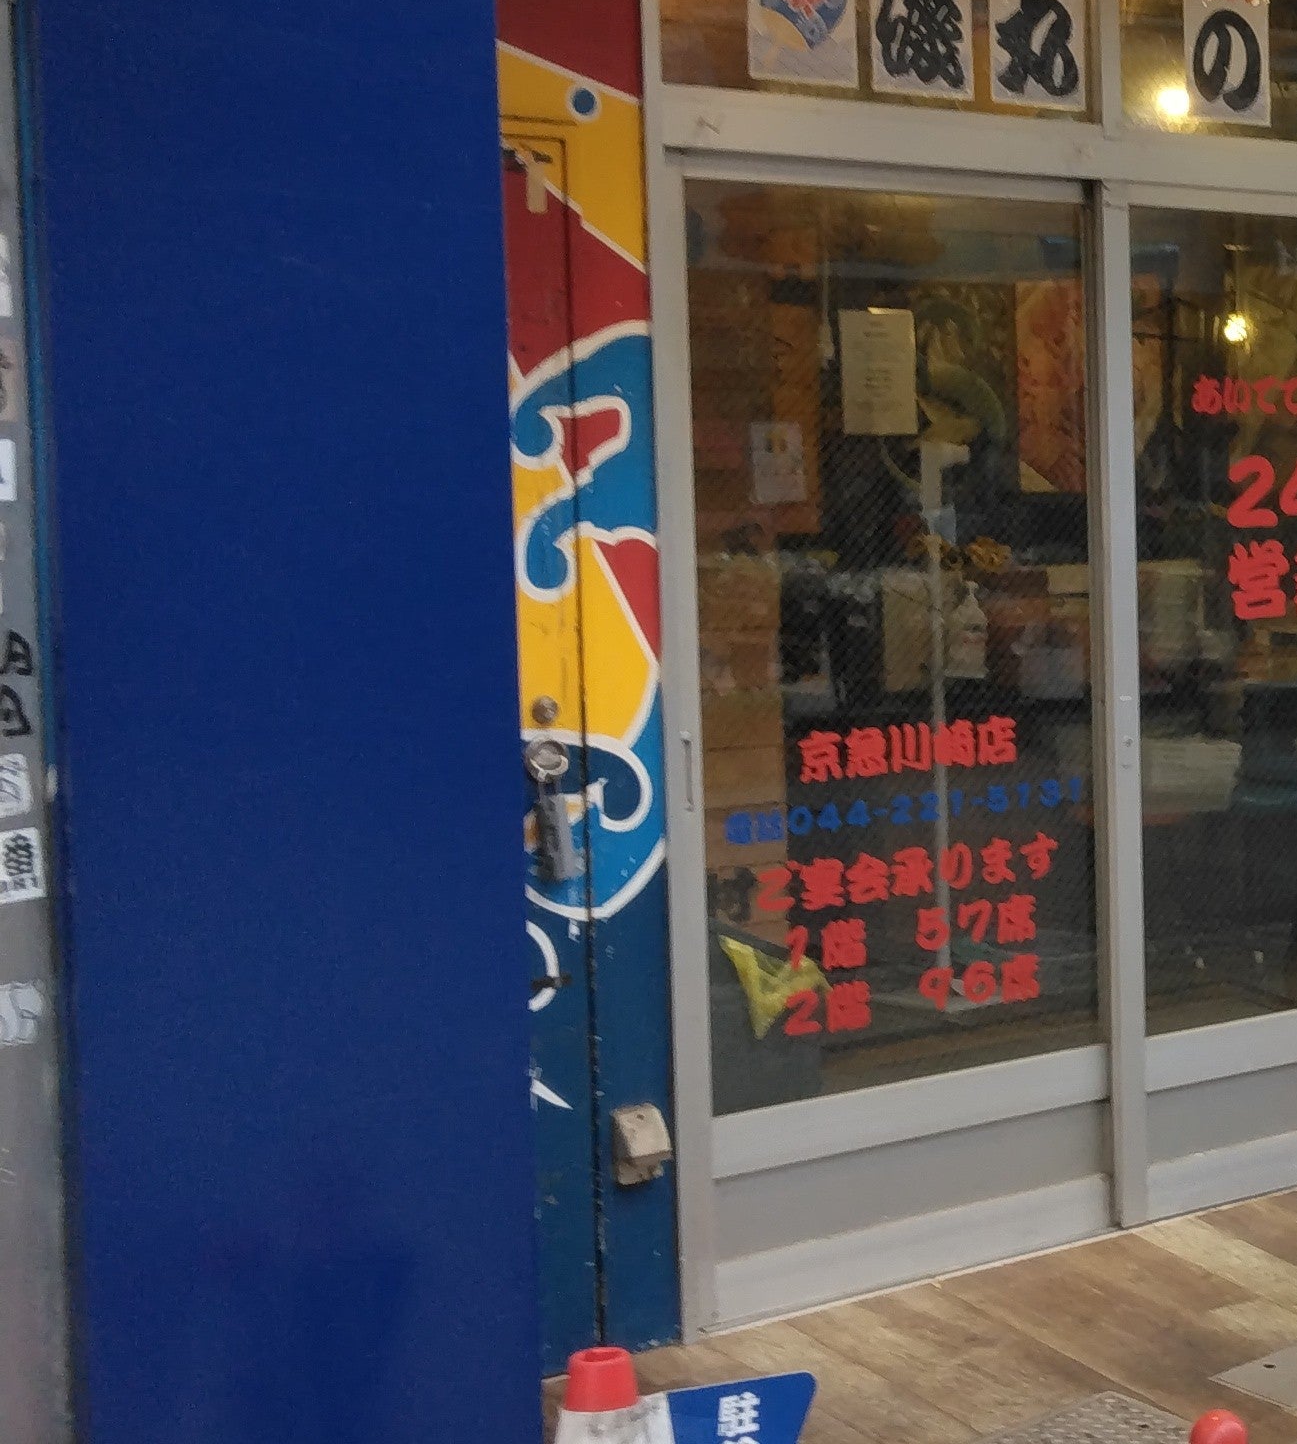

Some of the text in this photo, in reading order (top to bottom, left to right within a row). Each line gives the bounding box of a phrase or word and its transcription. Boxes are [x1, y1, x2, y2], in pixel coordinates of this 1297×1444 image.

[798, 715, 1017, 784] 京急川崎店
[784, 980, 871, 1036] 2階
[718, 1392, 761, 1444] 駐
